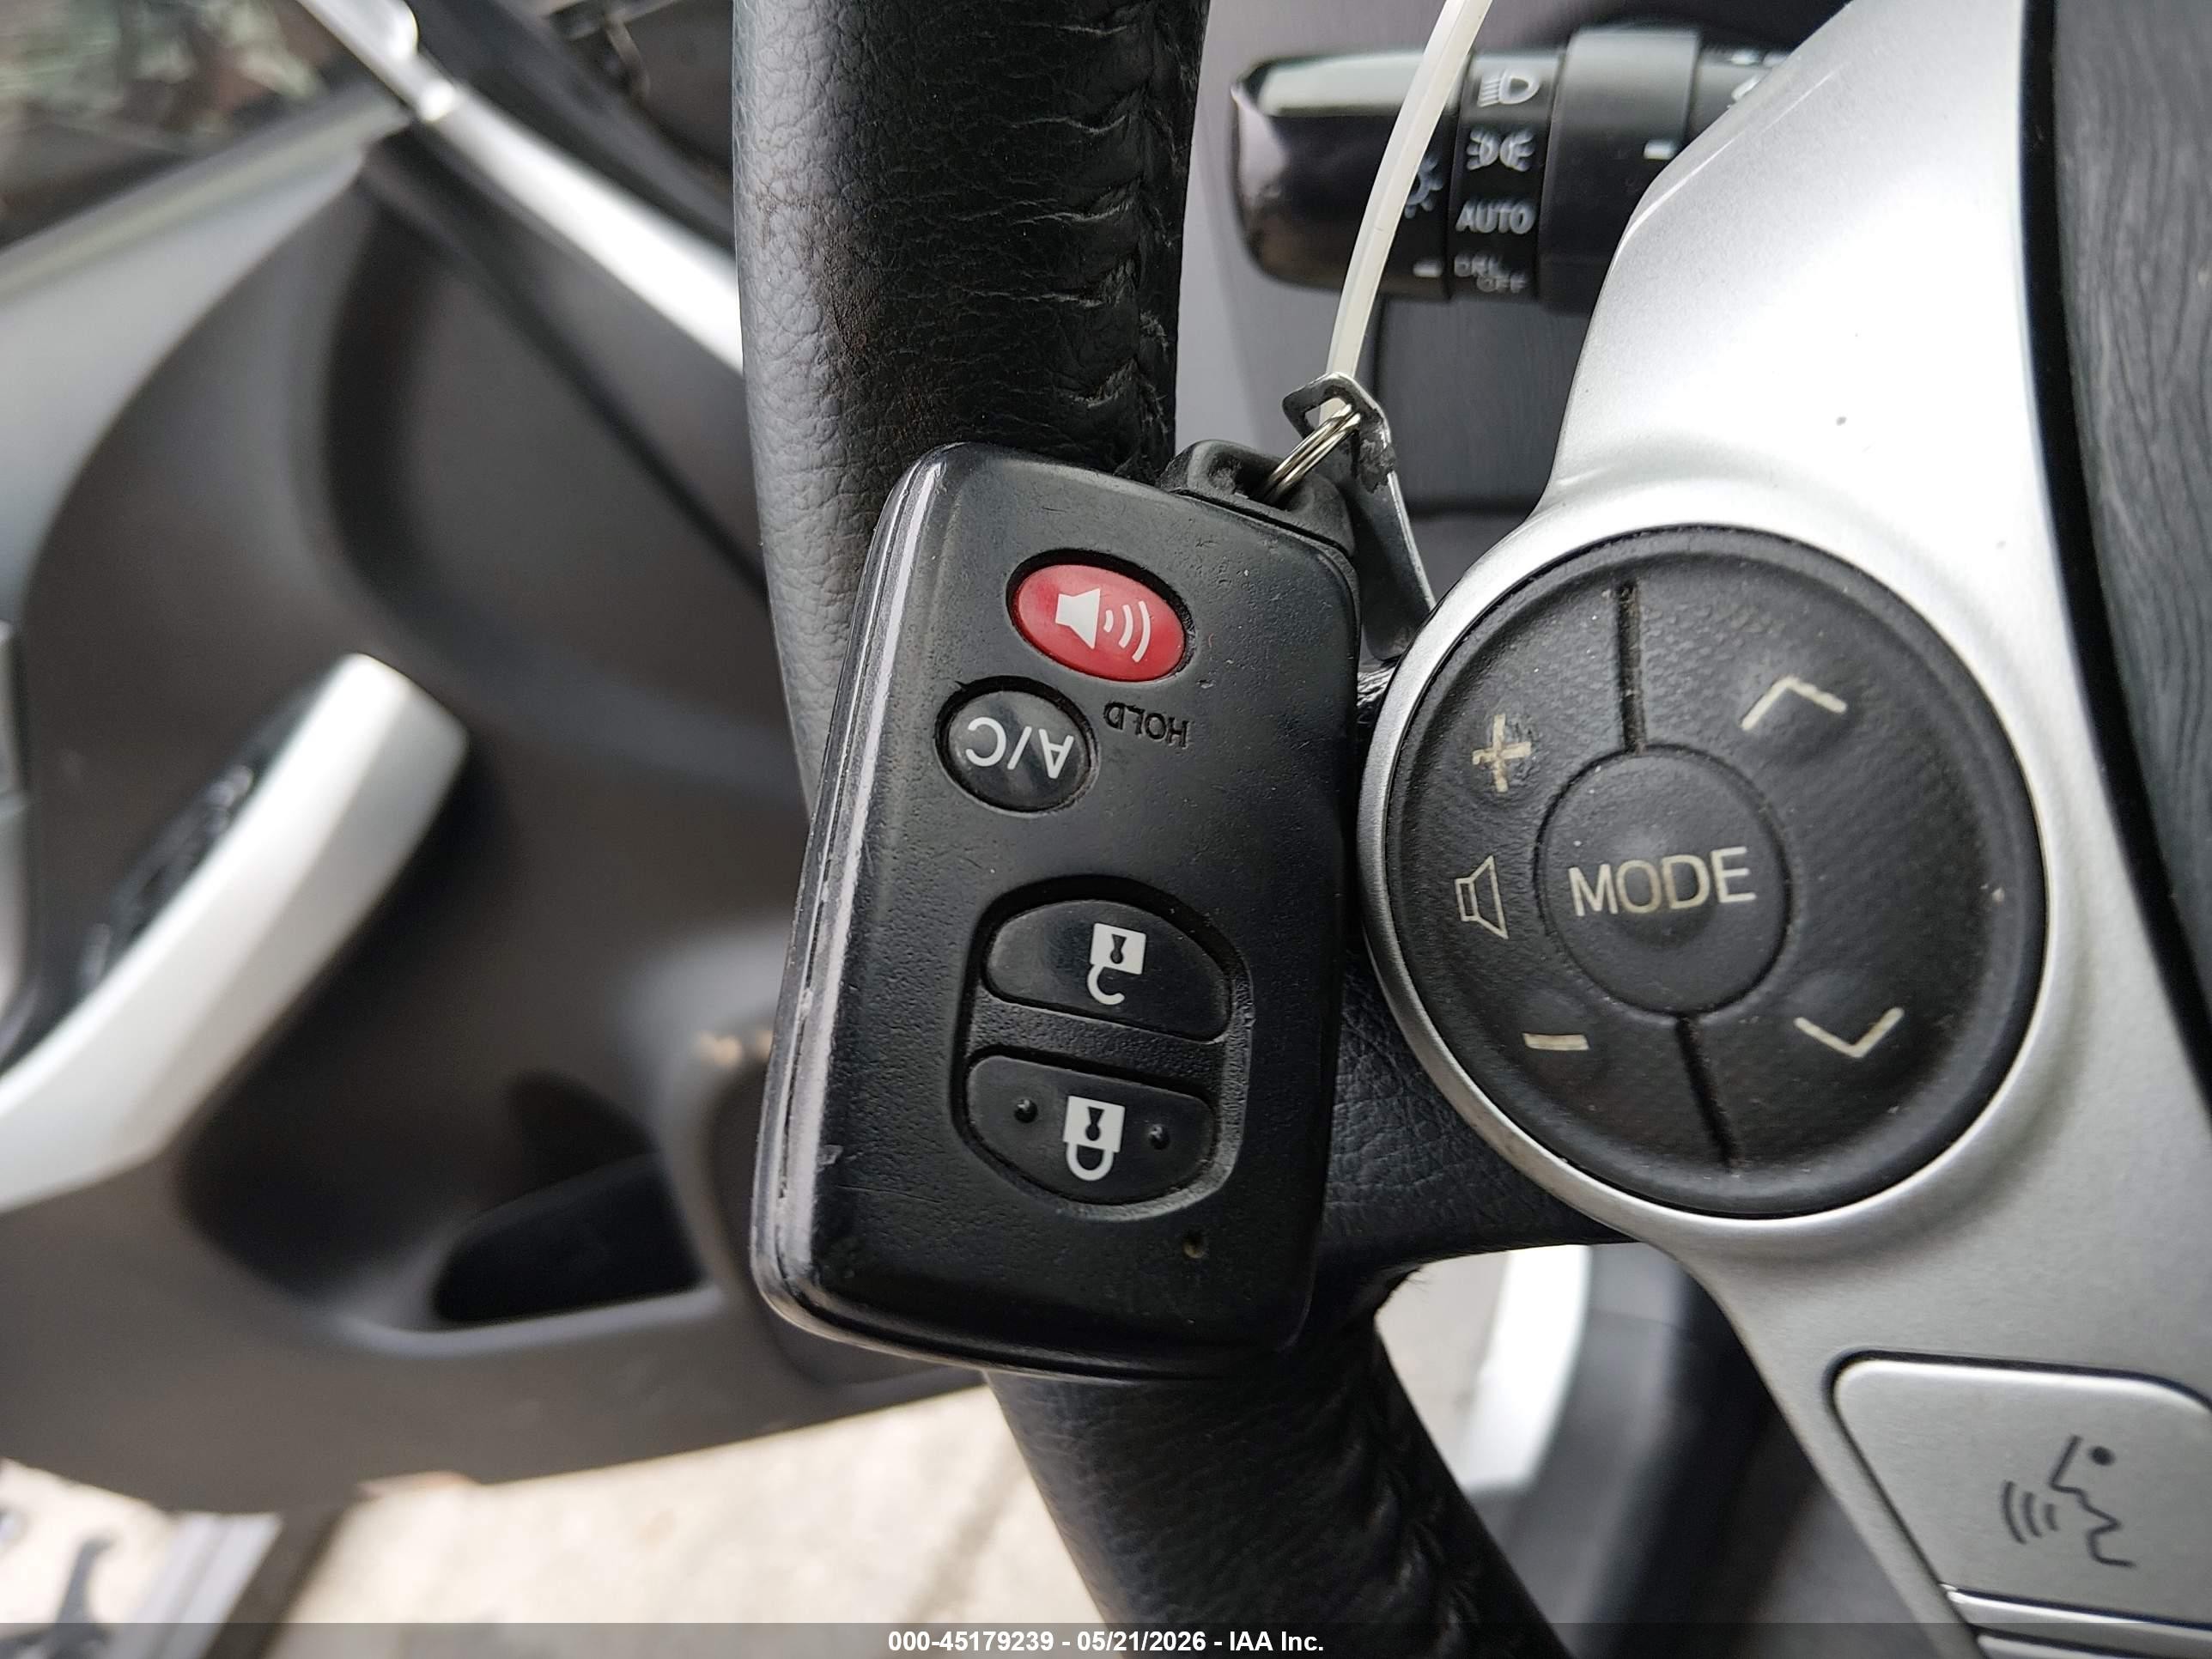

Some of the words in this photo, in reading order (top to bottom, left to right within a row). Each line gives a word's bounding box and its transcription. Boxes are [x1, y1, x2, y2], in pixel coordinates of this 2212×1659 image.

[1455, 200, 1535, 234] AUTO
[1476, 271, 1526, 293] OFF
[964, 716, 1074, 779] A/C
[1103, 701, 1189, 749] HOLD
[1568, 846, 1757, 917] MODE
